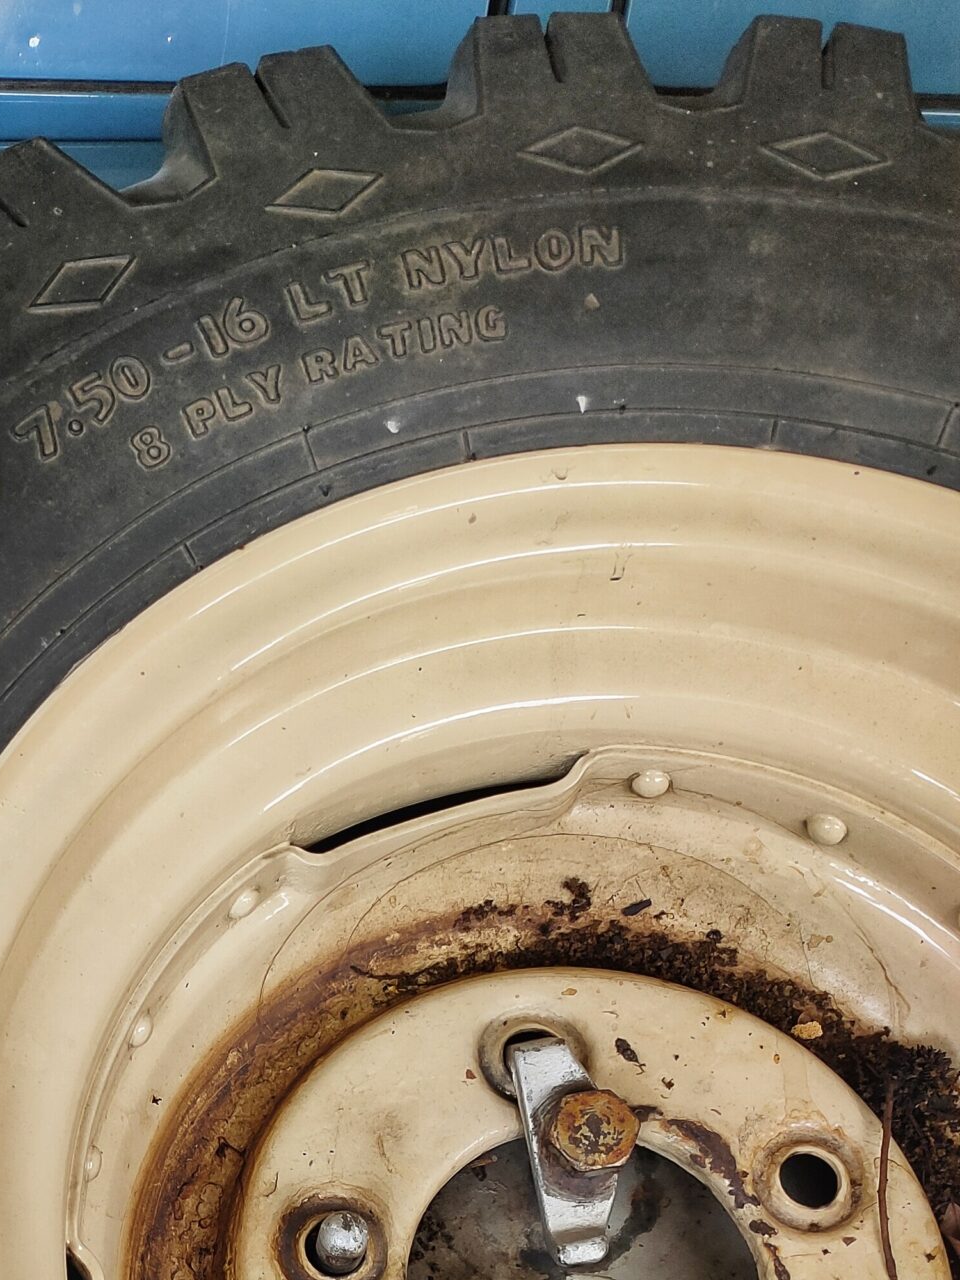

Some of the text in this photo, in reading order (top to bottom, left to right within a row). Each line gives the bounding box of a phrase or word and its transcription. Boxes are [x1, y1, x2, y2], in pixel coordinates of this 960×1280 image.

[284, 260, 375, 328] LT
[401, 224, 627, 292] NYLON
[130, 304, 510, 471] 8 PLY RATING
